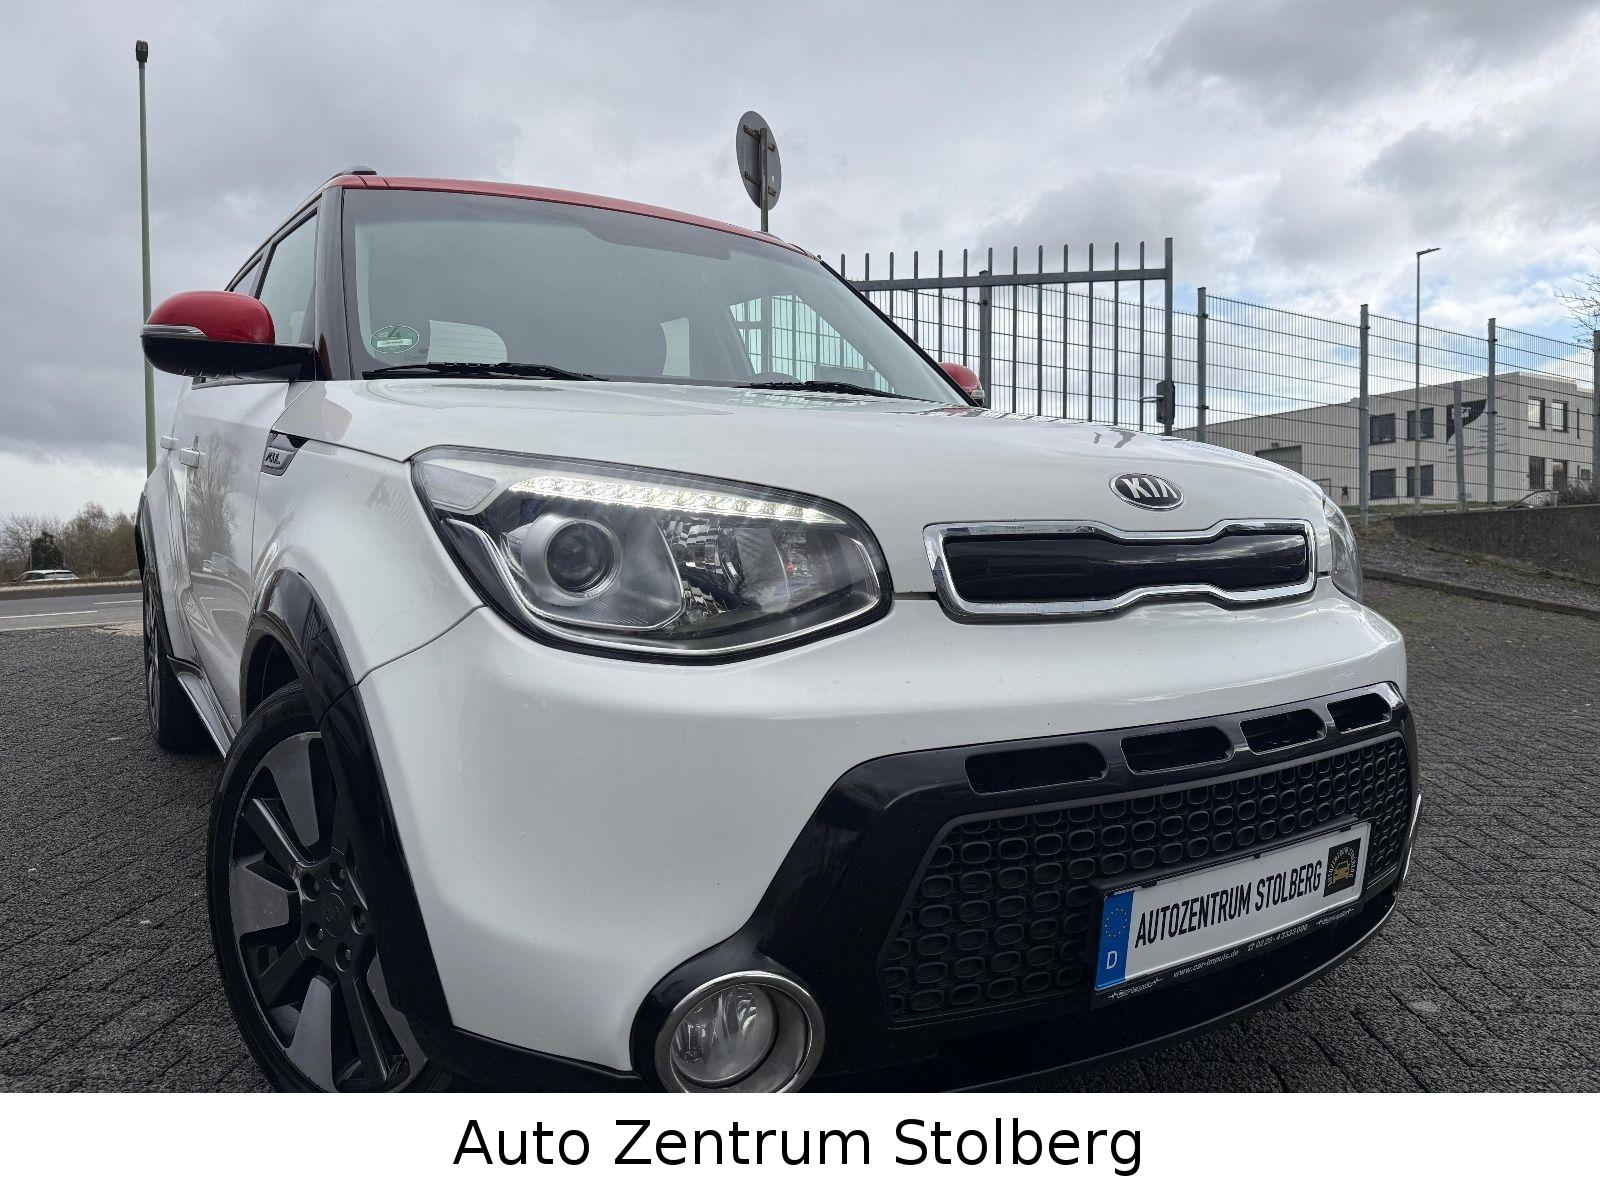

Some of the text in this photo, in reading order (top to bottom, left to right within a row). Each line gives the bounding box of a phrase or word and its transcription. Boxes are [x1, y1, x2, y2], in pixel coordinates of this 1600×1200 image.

[1120, 477, 1179, 499] KIA
[1134, 859, 1323, 949] AUTOZENTRUM STOLBERG
[1106, 950, 1118, 970] D
